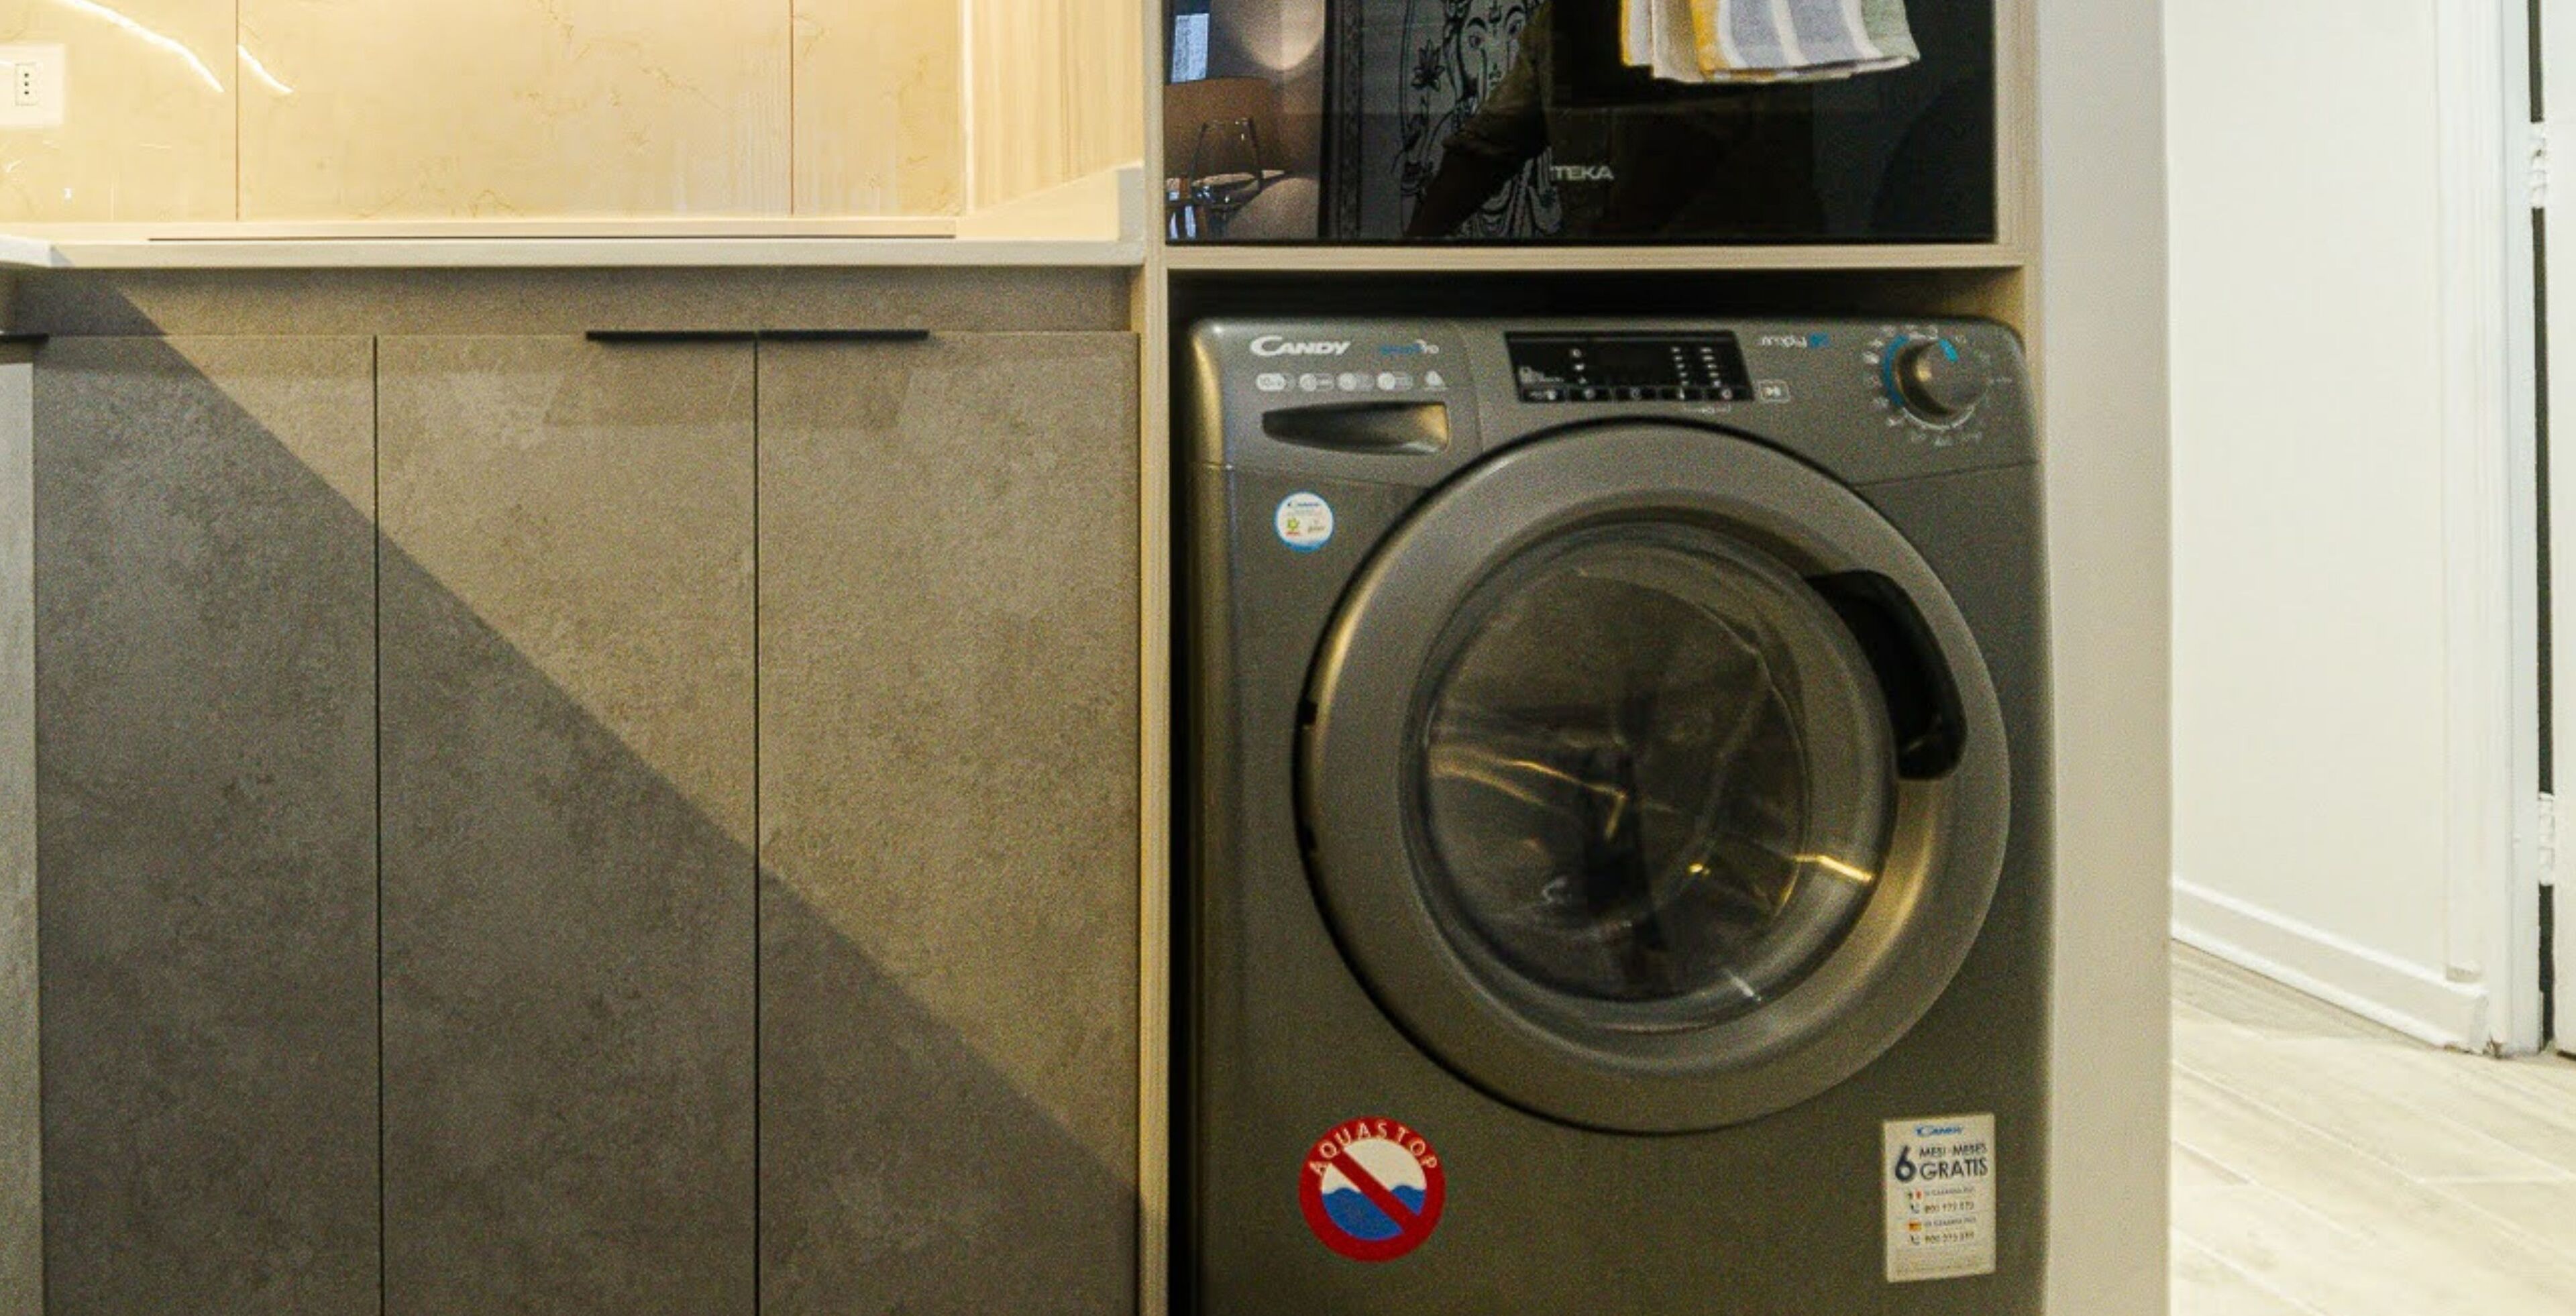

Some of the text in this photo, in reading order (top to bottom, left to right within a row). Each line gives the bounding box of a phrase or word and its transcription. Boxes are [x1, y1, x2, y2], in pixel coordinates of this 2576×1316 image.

[1550, 165, 1614, 180] TEKA
[1250, 335, 1351, 356] CANDY
[1309, 1119, 1438, 1176] AQUASTOP
[1919, 1142, 1988, 1158] MESI MESES
[1895, 1144, 1988, 1183] 6 GRATIS
